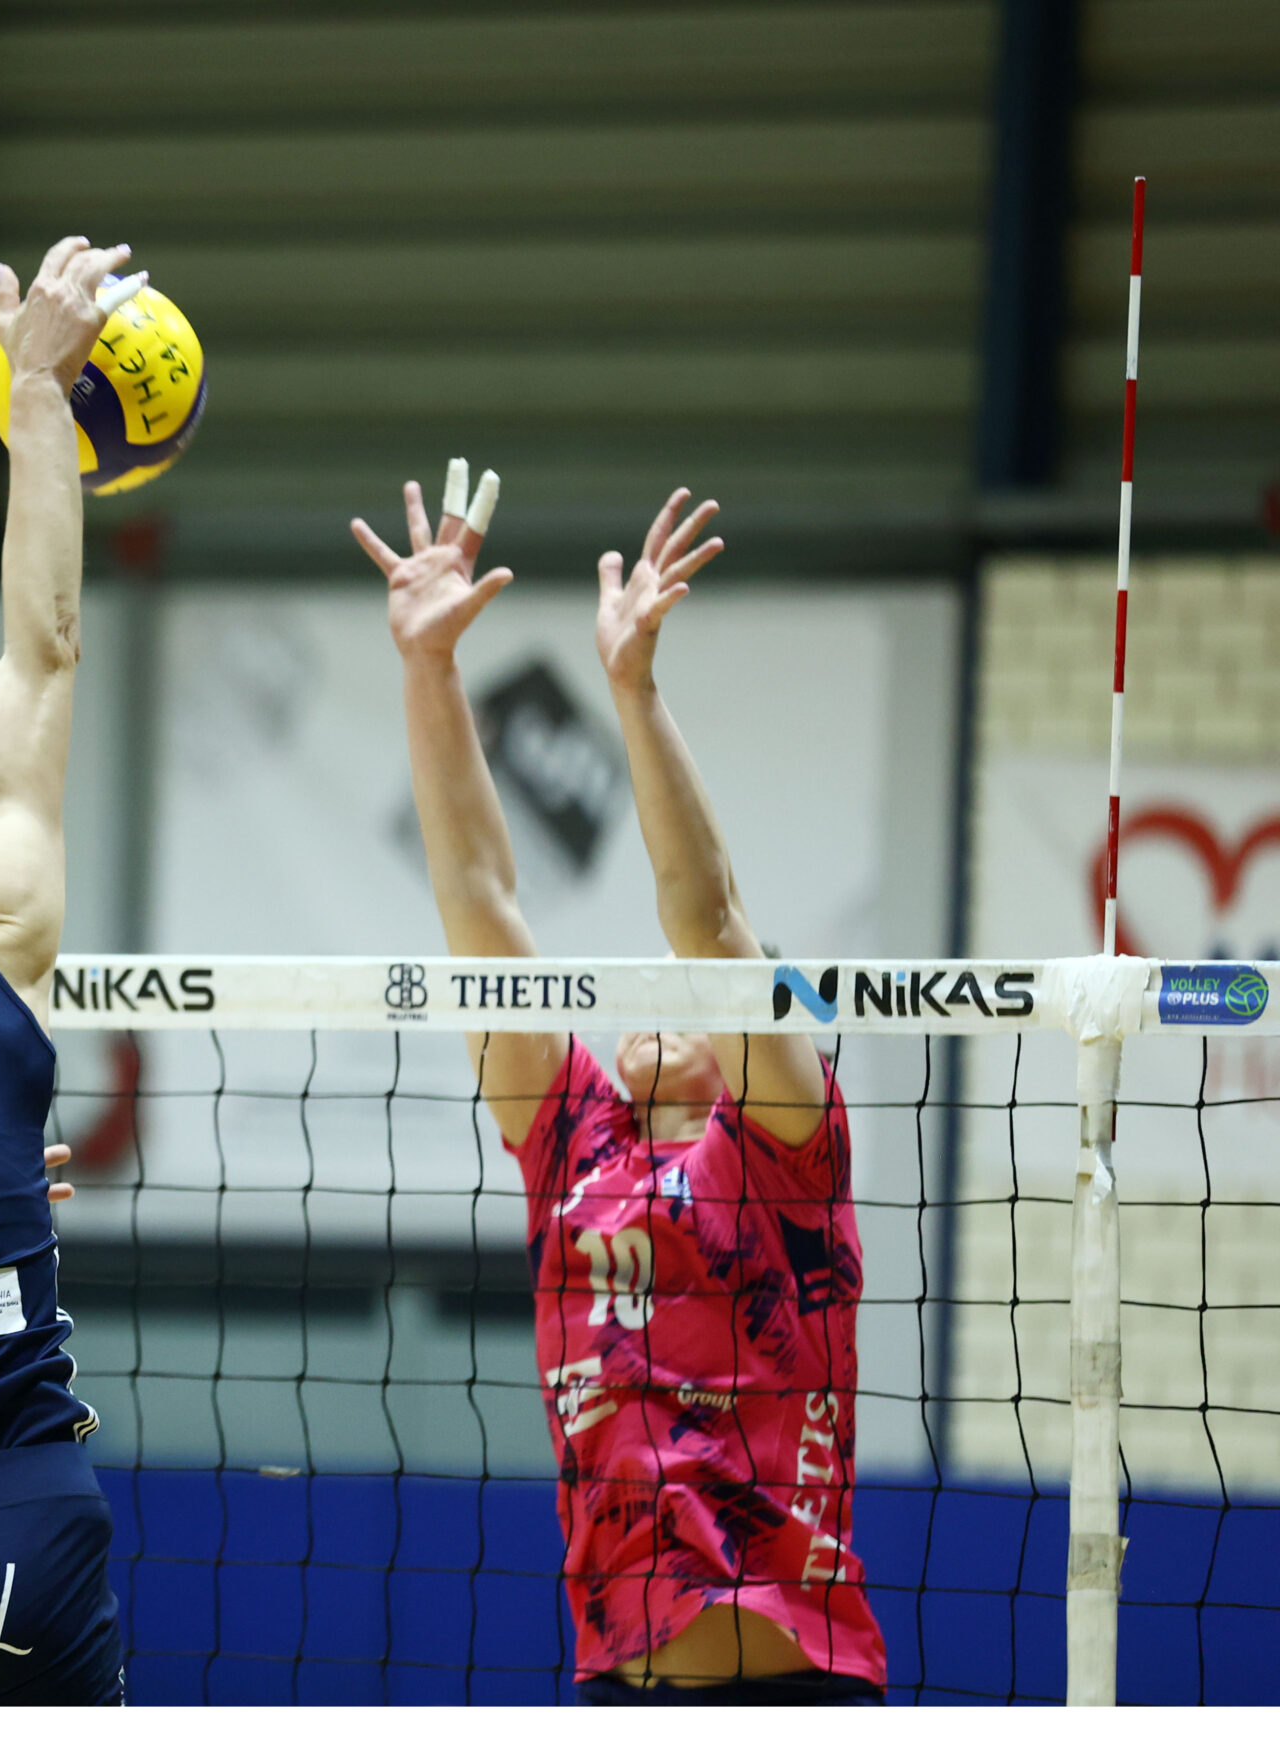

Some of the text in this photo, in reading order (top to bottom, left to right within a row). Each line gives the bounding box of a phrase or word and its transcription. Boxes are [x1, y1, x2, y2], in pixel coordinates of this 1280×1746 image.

[98, 332, 169, 435] THET
[451, 974, 597, 1010] THETIS
[1170, 978, 1220, 991] VOLLEY
[1182, 991, 1220, 1006] PLUS
[574, 1227, 655, 1330] 10
[677, 1382, 737, 1413] Group
